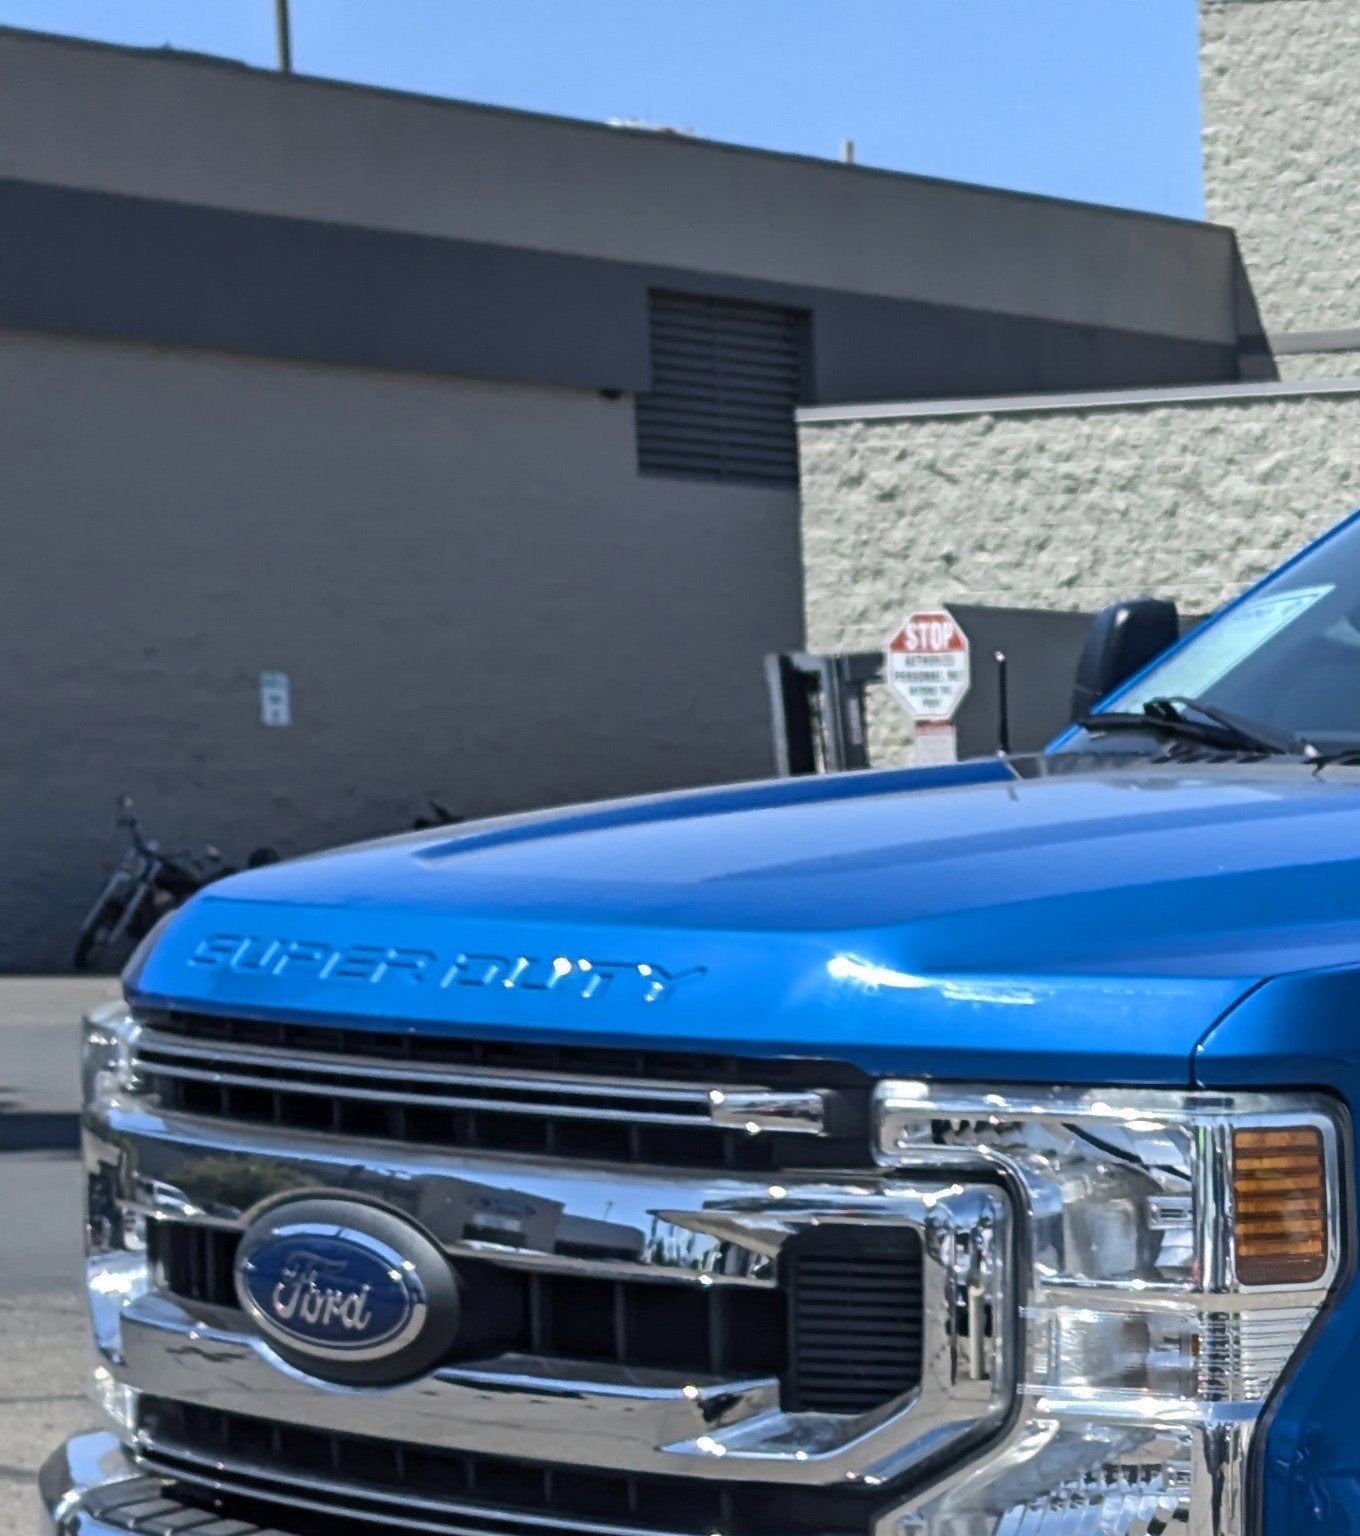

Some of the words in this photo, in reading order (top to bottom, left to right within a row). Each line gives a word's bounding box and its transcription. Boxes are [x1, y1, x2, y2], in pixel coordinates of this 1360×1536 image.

[905, 622, 953, 650] STOP
[188, 931, 433, 985] SUPER
[439, 952, 708, 1002] DUTY
[272, 1250, 372, 1330] Ford
